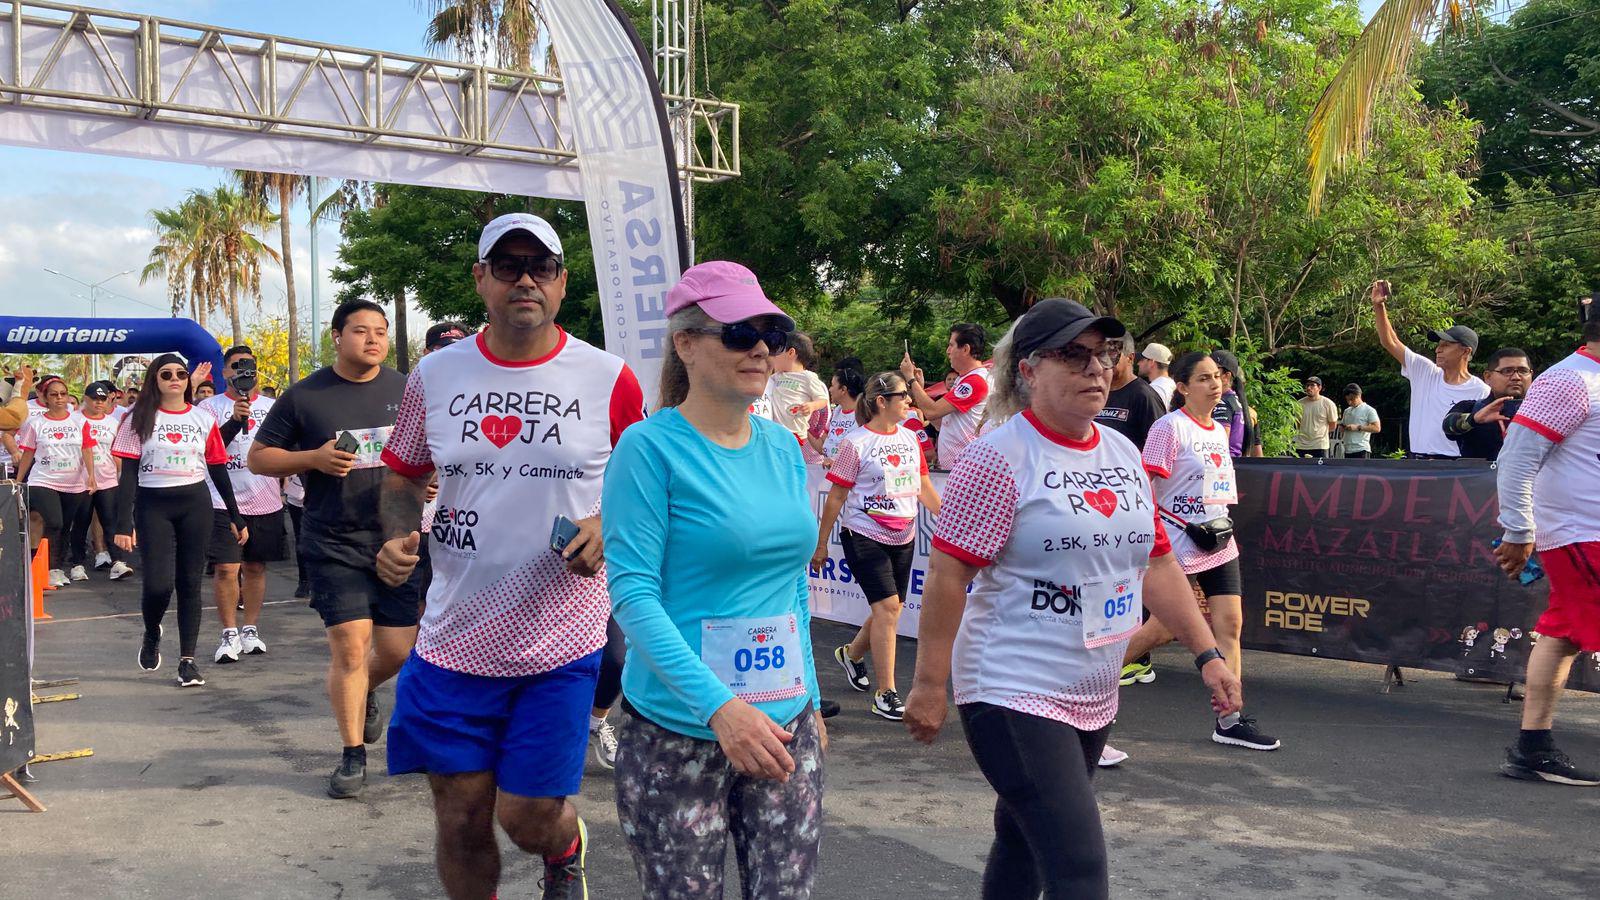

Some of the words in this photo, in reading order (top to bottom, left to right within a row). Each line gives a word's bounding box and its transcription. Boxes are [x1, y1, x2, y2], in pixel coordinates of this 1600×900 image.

[449, 391, 582, 420] CARRERA
[152, 423, 202, 434] CARRERA
[166, 456, 187, 464] 111
[475, 462, 494, 476] 5K
[502, 466, 512, 480] y
[519, 464, 584, 480] Caminata
[895, 476, 912, 487] 071
[1213, 481, 1230, 491] 042
[863, 502, 896, 510] DONA
[1172, 503, 1207, 515] DONA
[1043, 536, 1087, 552] 2.5K,
[1093, 533, 1109, 547] 5K
[1114, 535, 1122, 549] y
[1104, 593, 1134, 619] 057
[1265, 590, 1371, 618] POWER
[1264, 610, 1324, 632] ADE
[747, 626, 778, 635] CARRERA
[734, 645, 785, 672] 058
